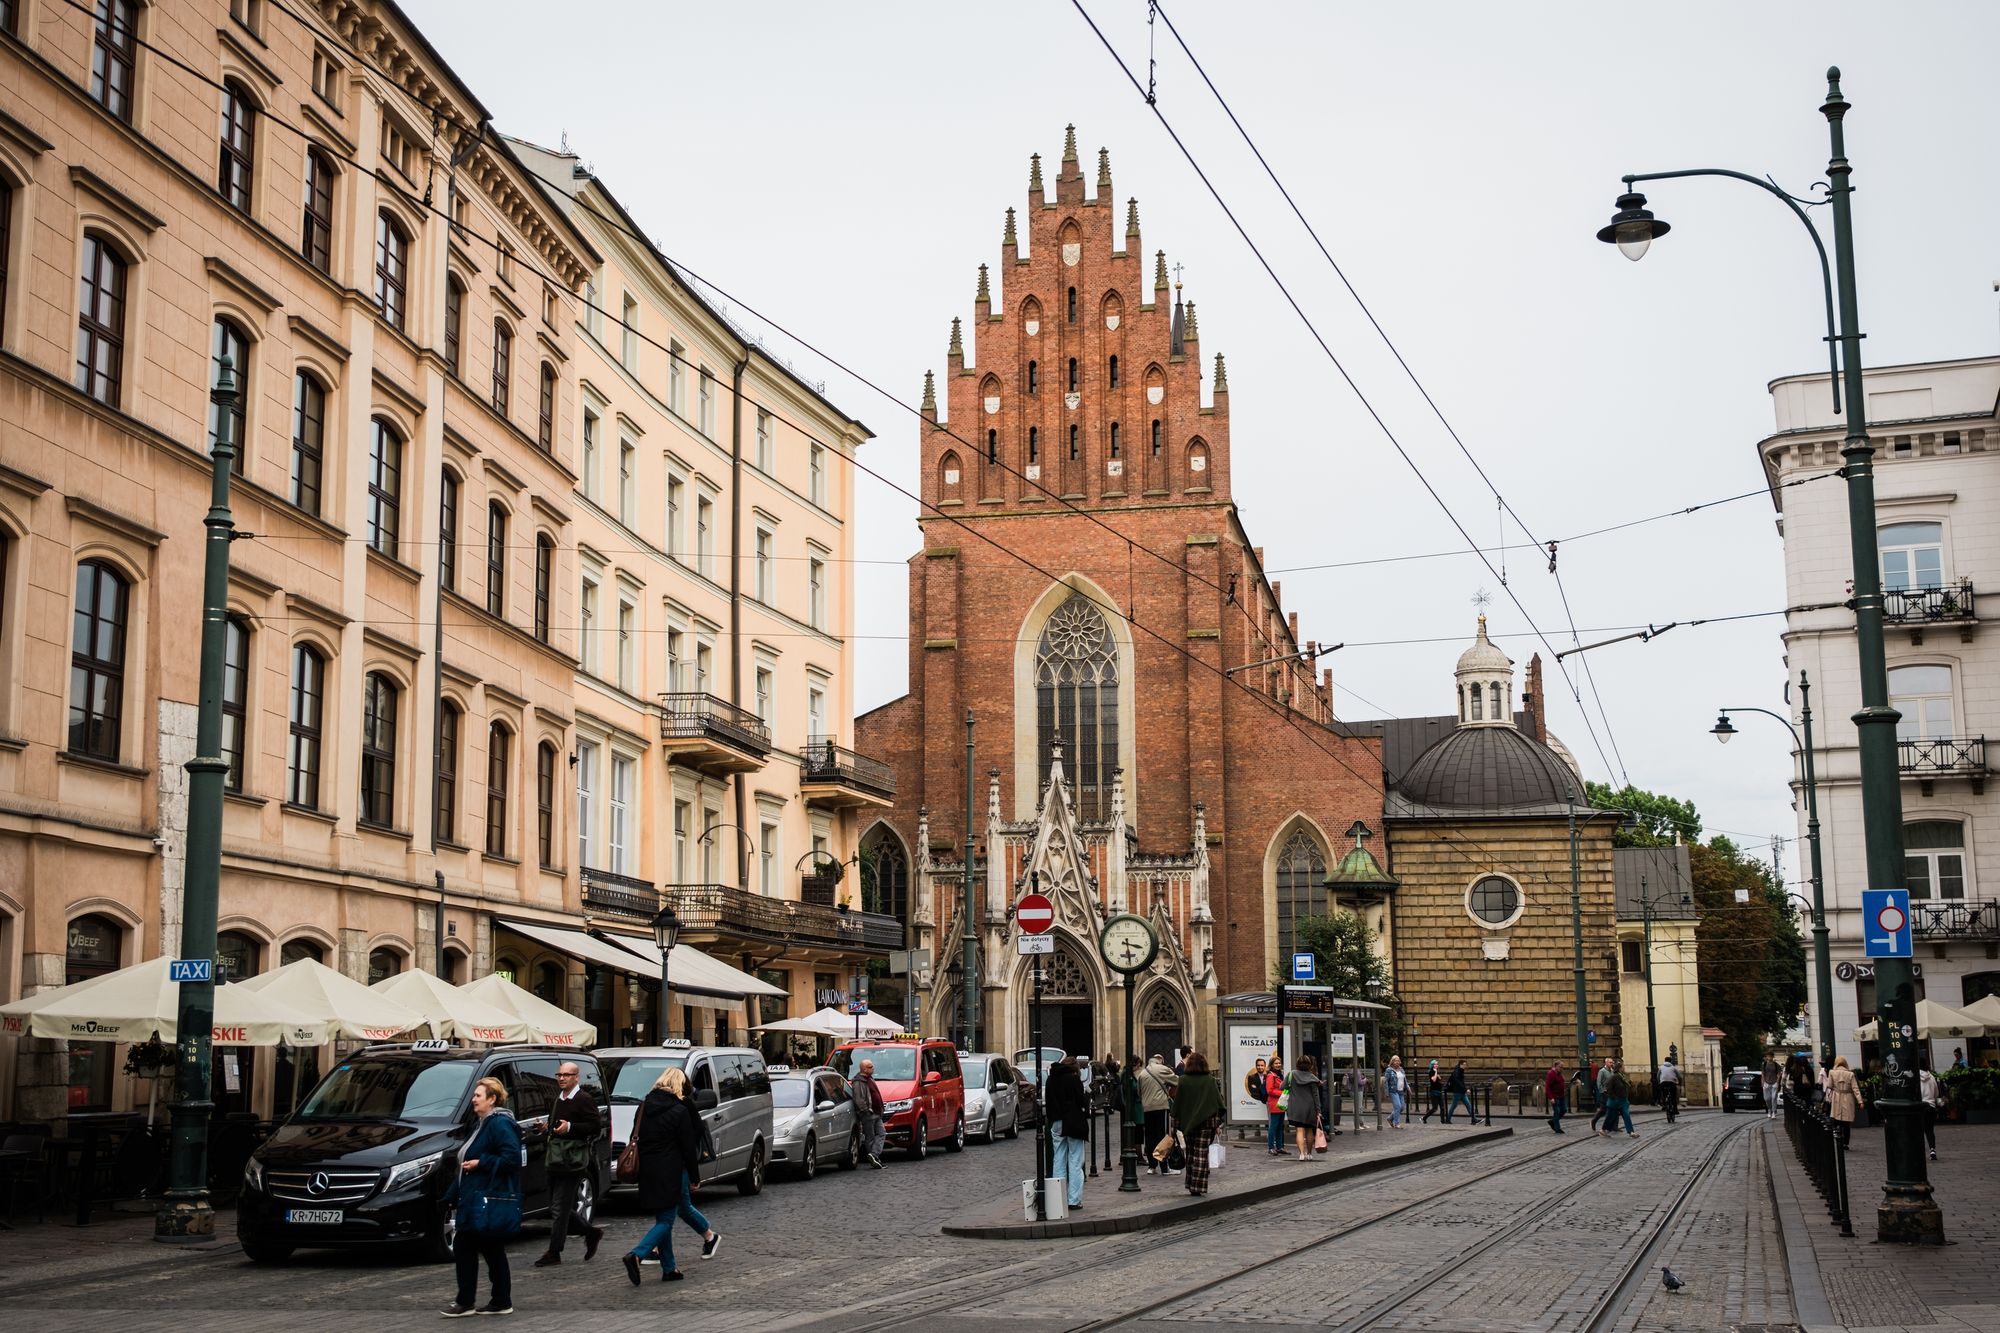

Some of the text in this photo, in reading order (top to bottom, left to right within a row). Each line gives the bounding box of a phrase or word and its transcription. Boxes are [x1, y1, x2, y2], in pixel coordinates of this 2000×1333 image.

[78, 935, 100, 947] BEEF
[172, 962, 209, 978] TAXI
[212, 1028, 247, 1040] SKIE
[472, 1028, 505, 1039] TYSKIE
[544, 1034, 574, 1044] TYSKIE
[416, 1040, 444, 1048] TAXI
[292, 1211, 304, 1222] KR
